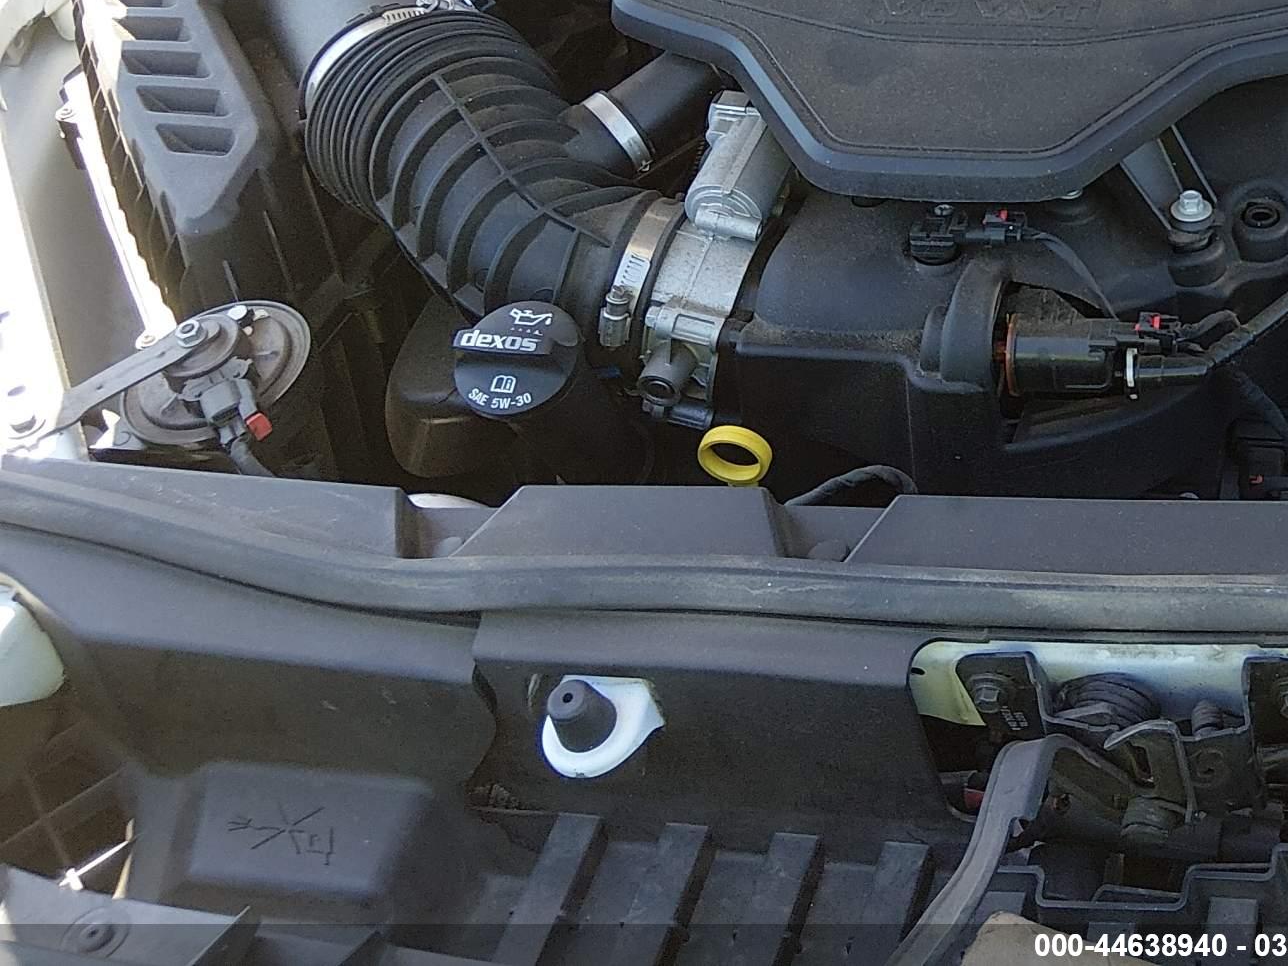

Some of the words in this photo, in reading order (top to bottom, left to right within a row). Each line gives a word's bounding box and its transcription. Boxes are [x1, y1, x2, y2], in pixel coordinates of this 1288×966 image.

[460, 329, 542, 352] dexos
[469, 389, 487, 405] SAE
[492, 393, 531, 408] 5W-30
